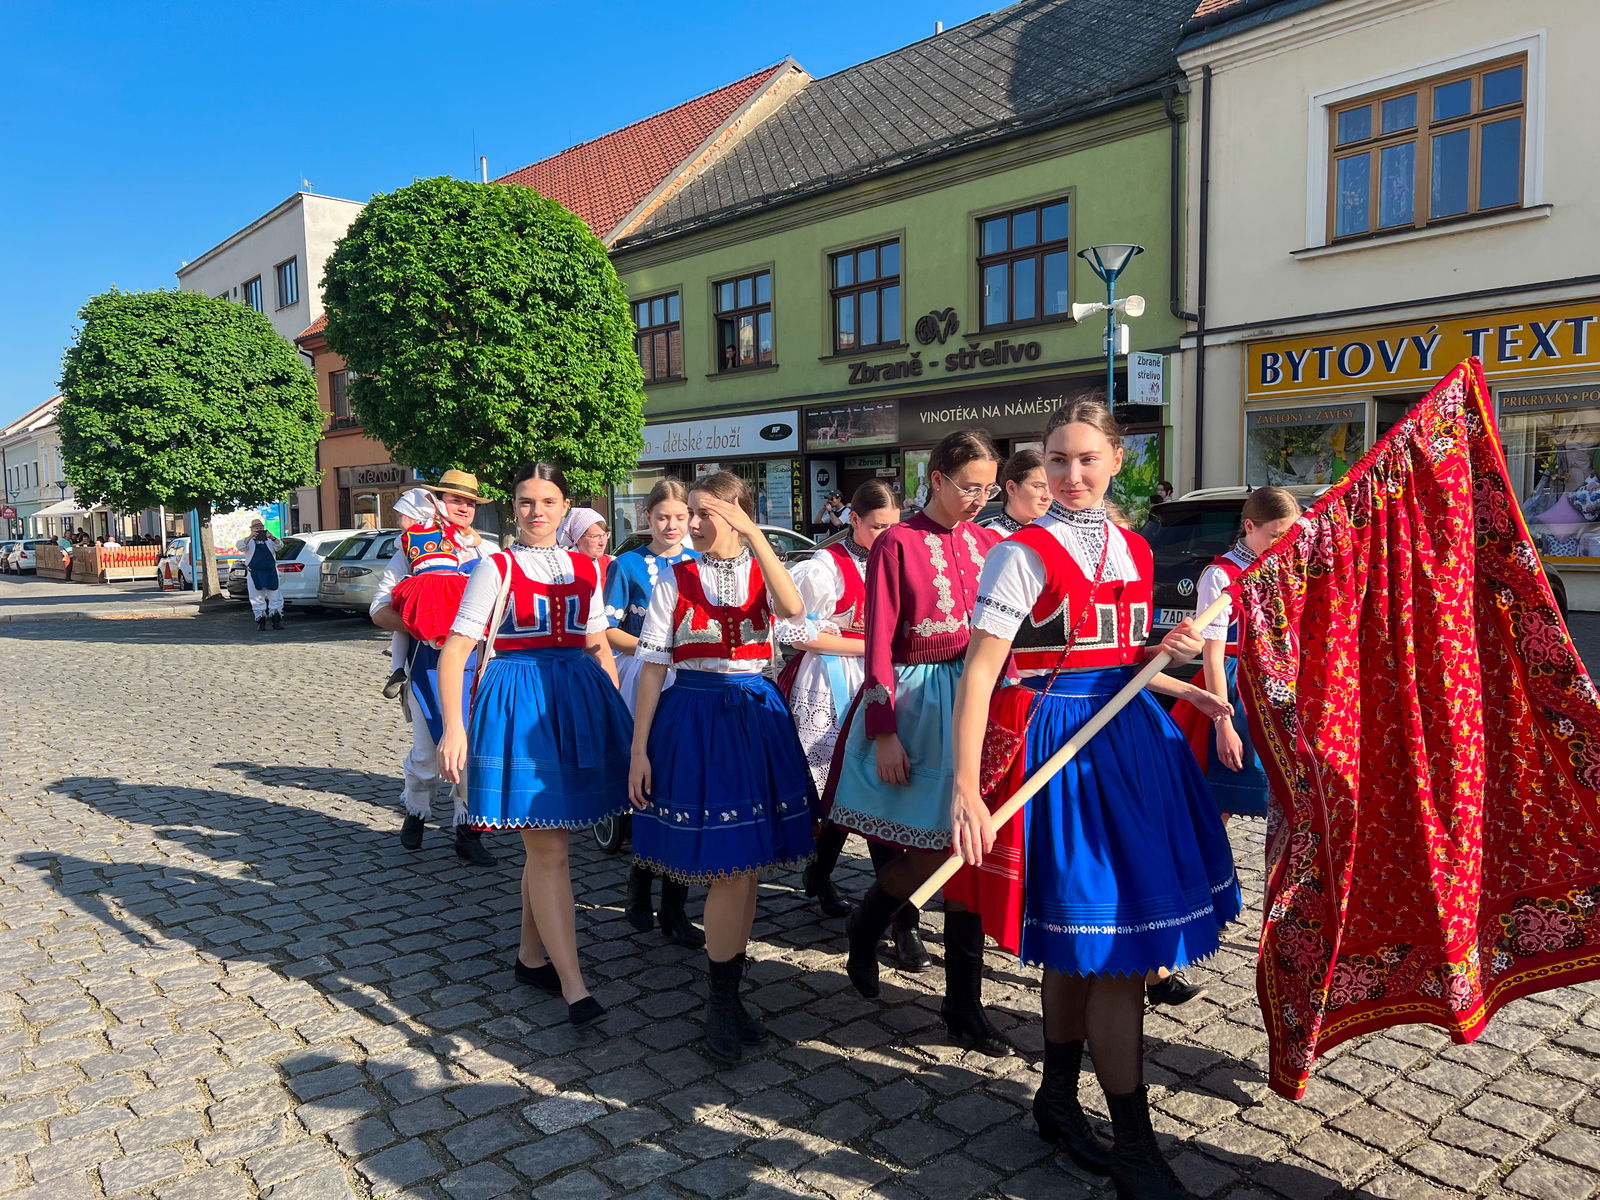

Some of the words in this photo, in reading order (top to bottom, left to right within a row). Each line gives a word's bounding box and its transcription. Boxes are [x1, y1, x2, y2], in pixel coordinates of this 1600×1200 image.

[848, 351, 922, 385] Zbraně
[945, 339, 1042, 373] střelivo
[1137, 356, 1161, 367] Zbraně
[1260, 325, 1443, 386] BYTOVÝ
[1462, 315, 1598, 364] TEXT
[1137, 370, 1161, 381] střelivo
[919, 405, 979, 425] VINOTÉKA
[982, 406, 1001, 419] NA
[1004, 394, 1064, 416] NÁMĚSTÍ
[662, 429, 703, 453] dětské
[705, 426, 742, 450] zboží
